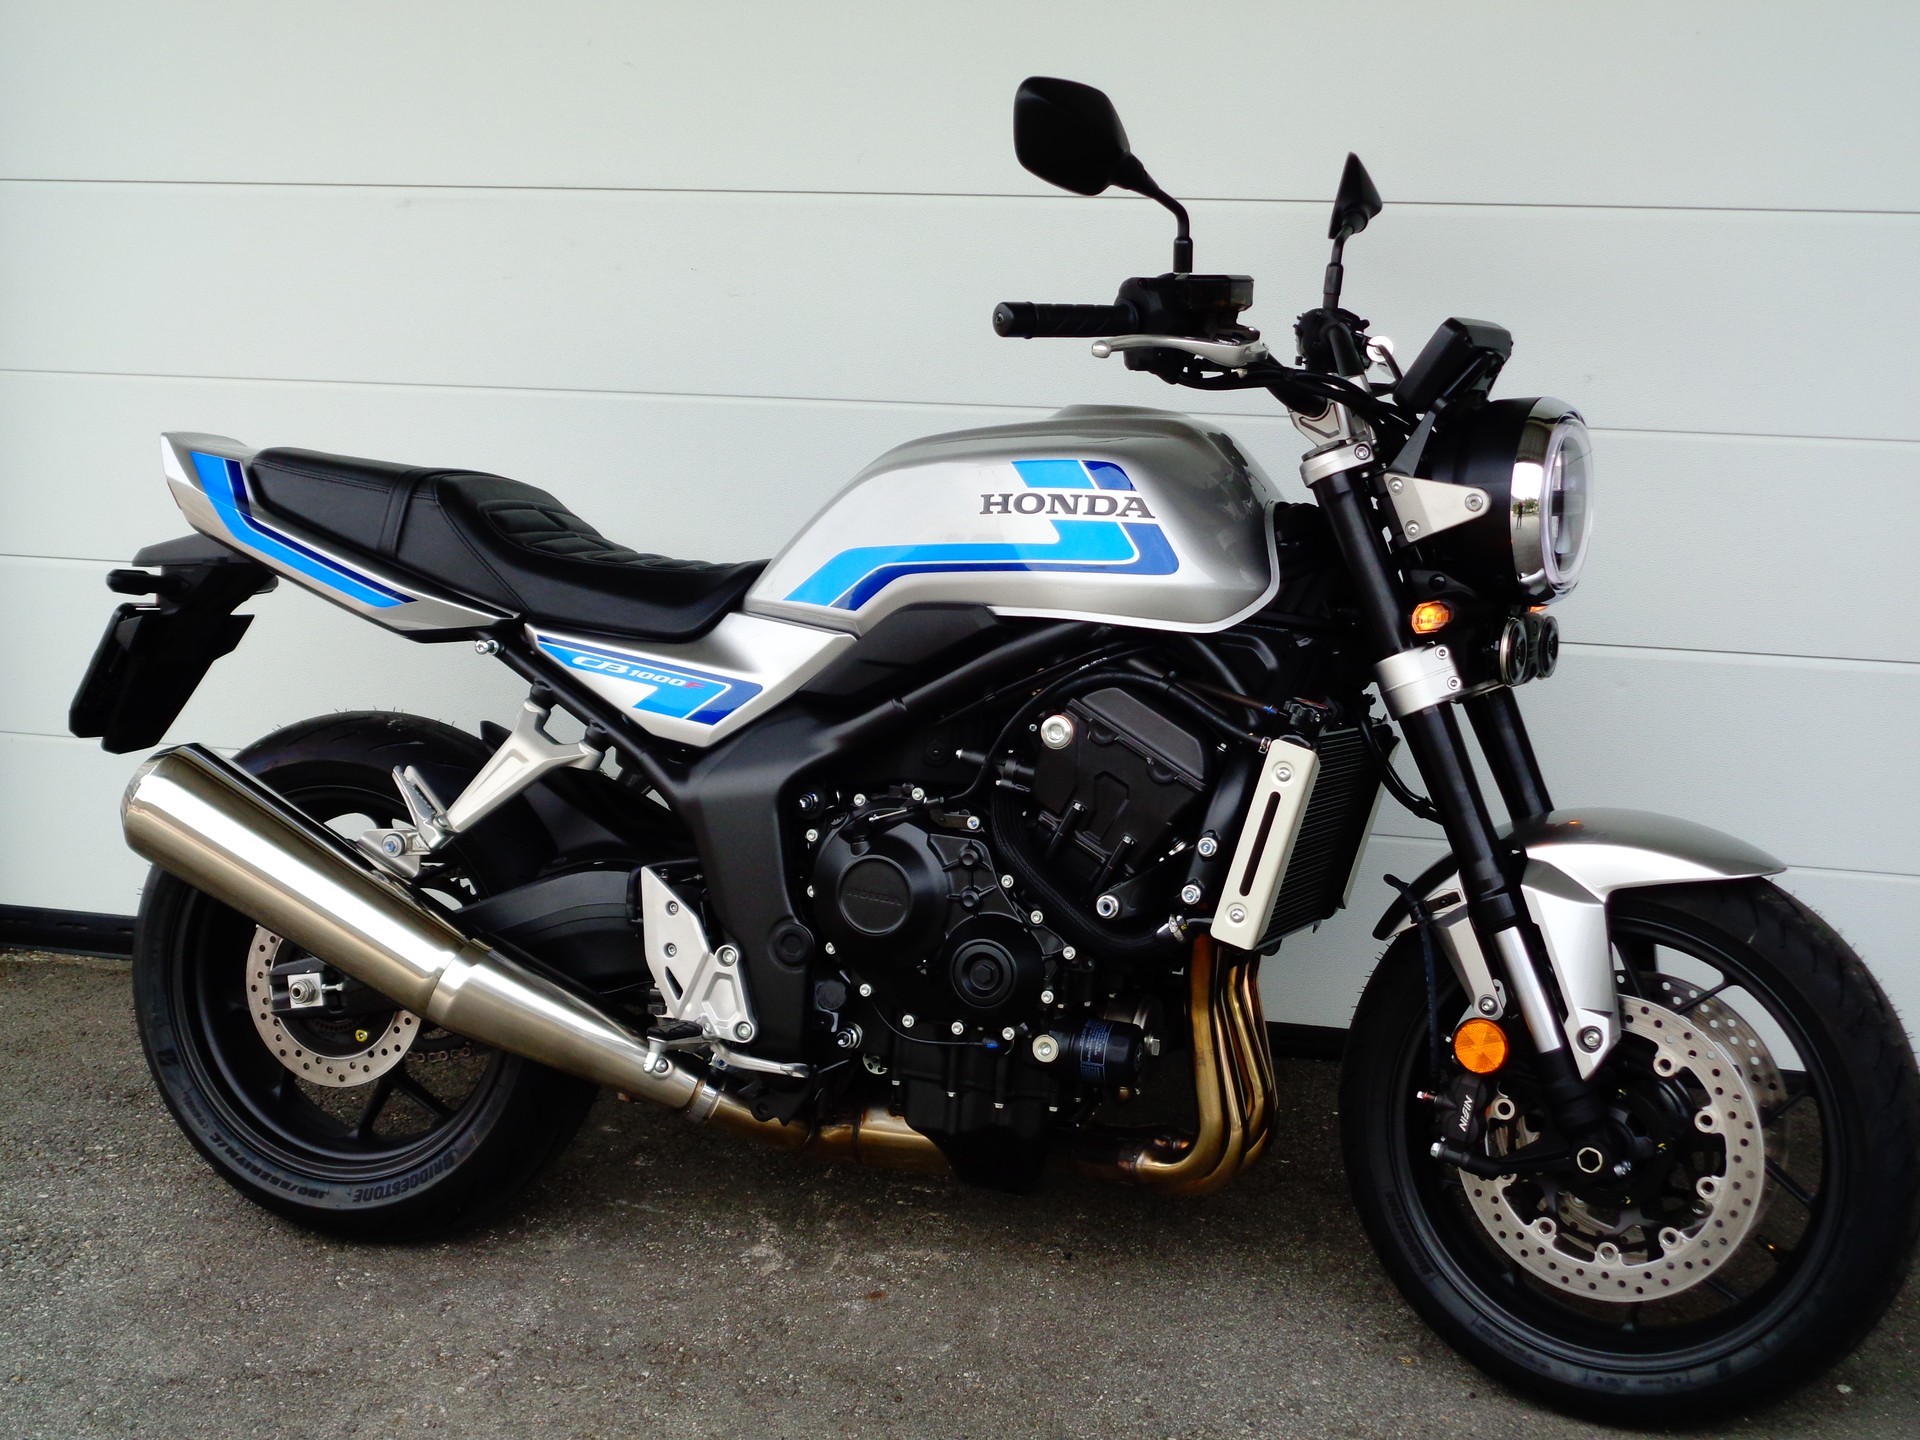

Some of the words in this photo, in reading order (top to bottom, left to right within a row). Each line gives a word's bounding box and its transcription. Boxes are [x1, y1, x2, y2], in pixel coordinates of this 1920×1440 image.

[979, 492, 1156, 518] HONDA
[843, 887, 903, 906] HONDA
[353, 1150, 454, 1201] BRIDGESTONE
